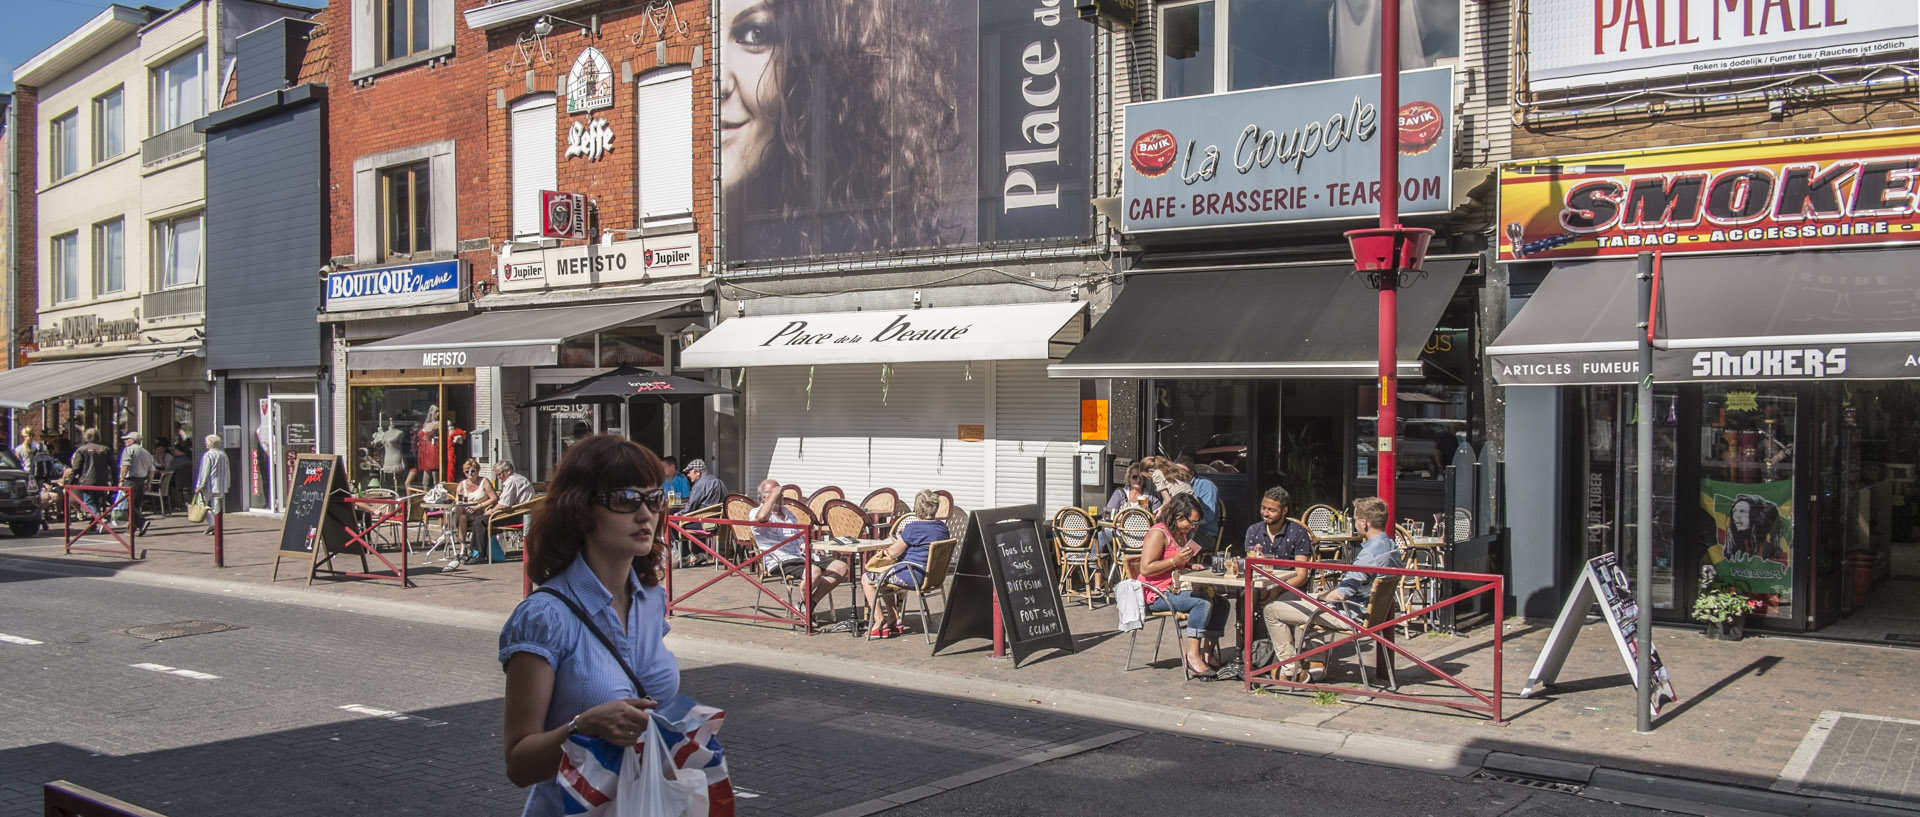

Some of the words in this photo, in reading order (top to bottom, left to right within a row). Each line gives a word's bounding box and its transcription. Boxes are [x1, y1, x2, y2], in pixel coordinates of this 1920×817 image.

[1594, 0, 1700, 55] PALL
[1692, 62, 1719, 71] Roken
[1720, 61, 1728, 69] is
[1729, 57, 1762, 68] dodelijk
[1769, 53, 1797, 63] Fumer
[1798, 51, 1813, 60] tue
[1819, 46, 1858, 57] Rauchen
[1860, 44, 1872, 54] ist
[1873, 40, 1905, 52] tödlich
[1004, 39, 1061, 215] Place
[1399, 110, 1435, 126] BAVIK
[565, 117, 614, 160] Leffe
[1138, 139, 1170, 153] BAVIK
[1181, 138, 1220, 184] La
[1234, 94, 1377, 174] Coupole
[1129, 197, 1177, 221] CAFE
[1192, 186, 1307, 216] BRASSERIE
[1326, 175, 1441, 207] TEAROM
[574, 195, 584, 237] Jupiler
[1596, 232, 1677, 248] TABAC
[1710, 221, 1889, 243] ACCESSOIRE
[513, 265, 543, 279] Jupiler
[557, 253, 627, 276] MEFISTO
[654, 250, 690, 266] Jupiler
[331, 269, 413, 298] BOUTIQUE
[409, 272, 453, 297] Charme
[759, 320, 833, 346] Place
[833, 334, 849, 344] de
[848, 333, 862, 344] la
[869, 314, 973, 342] beauté
[423, 351, 467, 366] MEFISTO
[1502, 362, 1572, 376] ARTICLES
[1692, 348, 1848, 378] SMOKERS
[252, 451, 260, 495] SOLDES
[1589, 473, 1603, 509] TUBER
[1588, 510, 1602, 543] POUR
[1731, 566, 1783, 580] FREEDOM
[1019, 609, 1040, 622] FOOT
